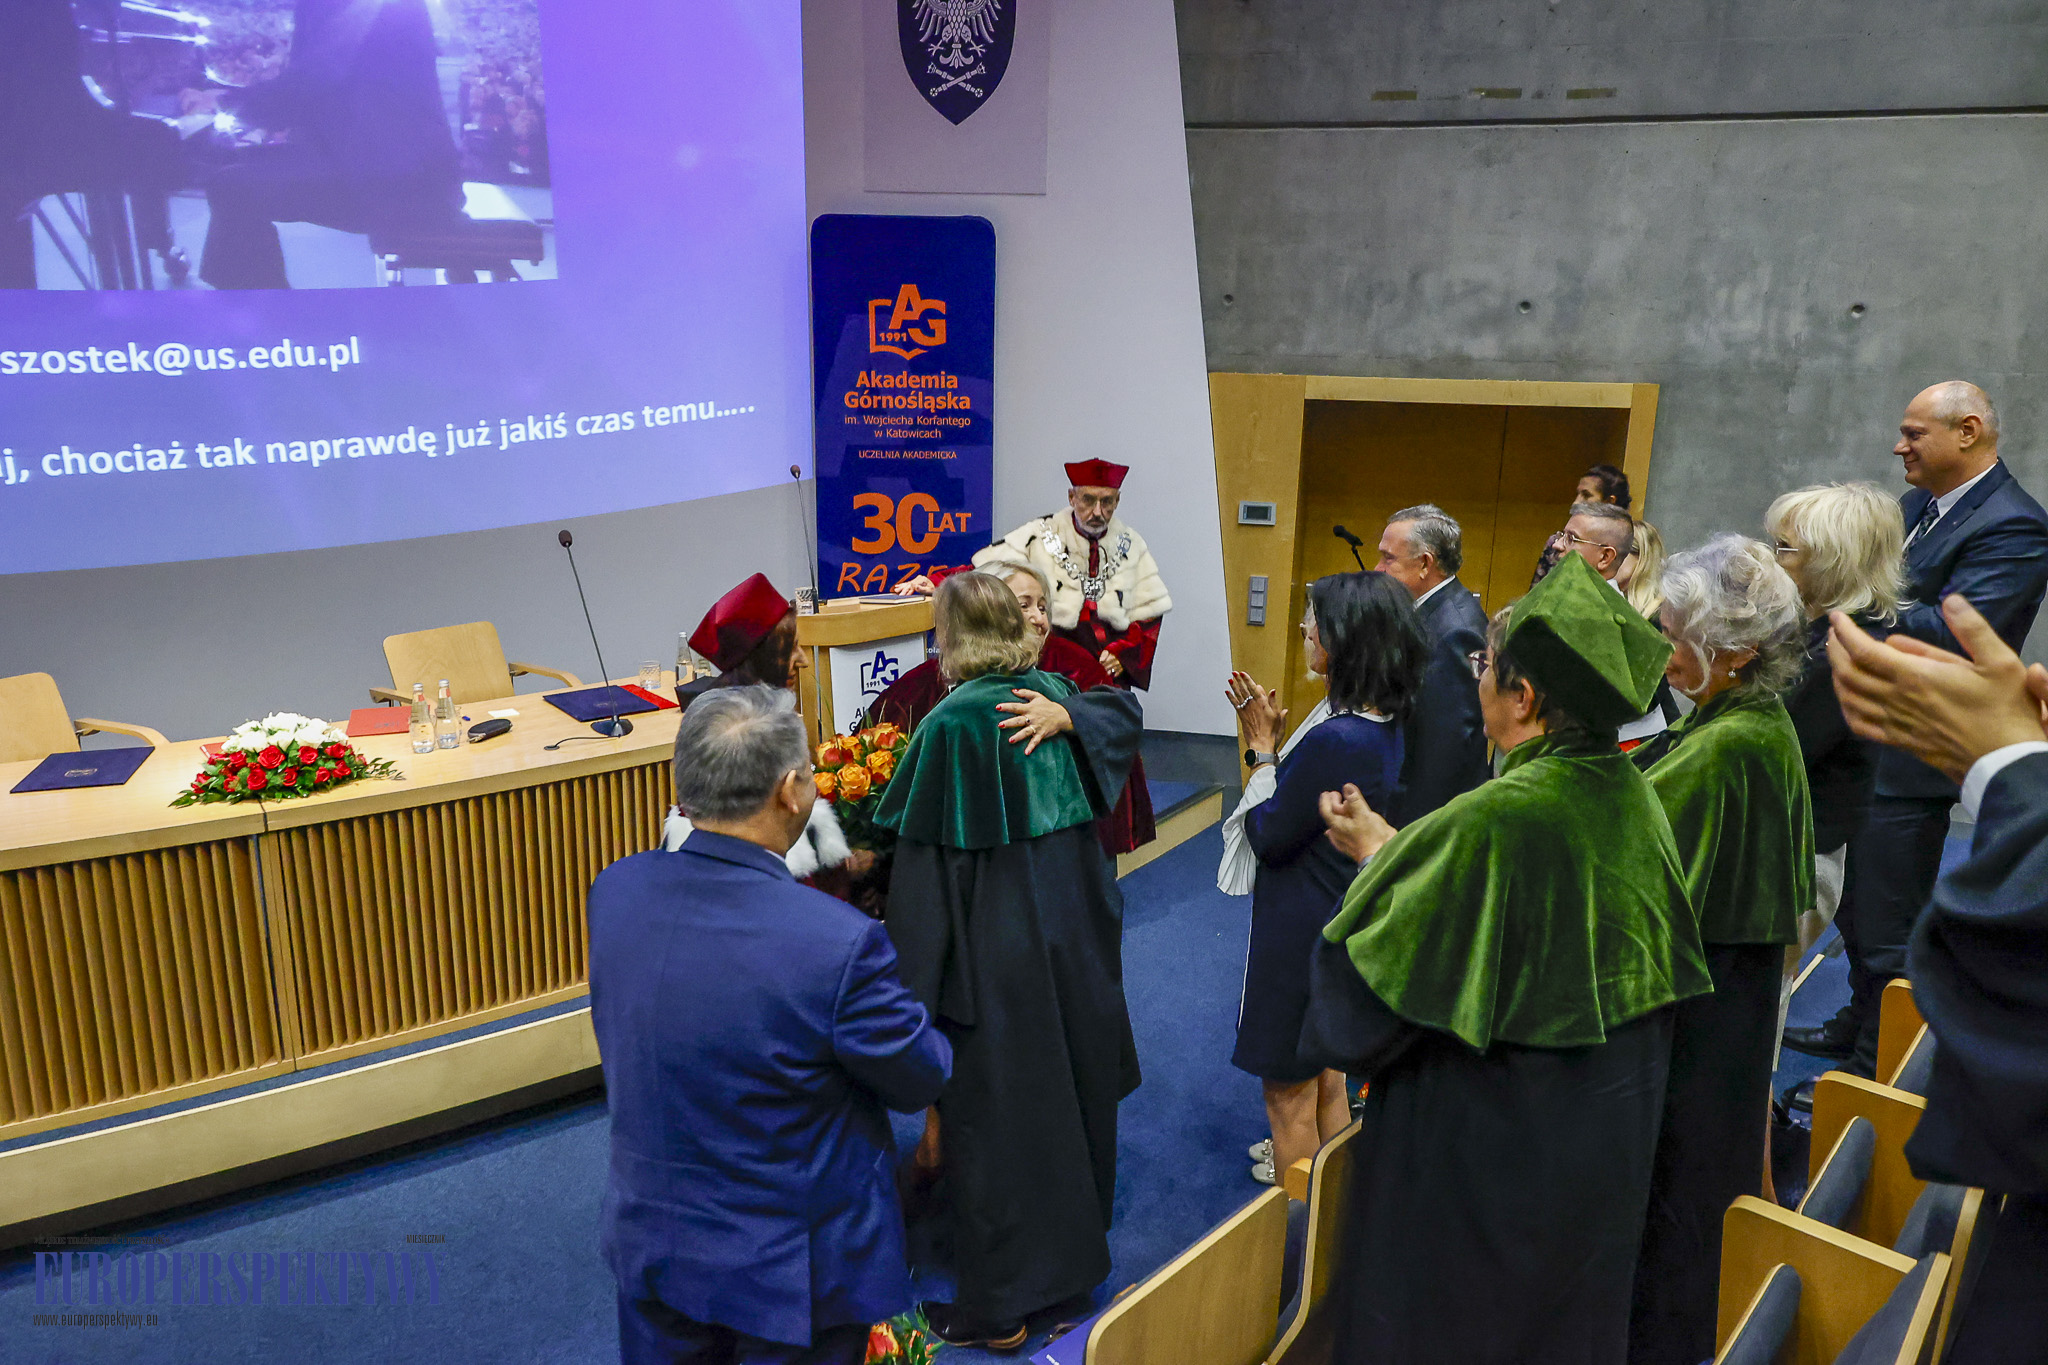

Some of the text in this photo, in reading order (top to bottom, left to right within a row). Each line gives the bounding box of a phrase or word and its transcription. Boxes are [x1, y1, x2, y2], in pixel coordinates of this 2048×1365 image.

[889, 284, 947, 346] AG
[879, 332, 907, 342] 1991
[0, 336, 361, 376] szostek@us.edu.pl
[856, 371, 958, 389] Akademia
[844, 391, 971, 413] Górnośląska
[844, 415, 971, 428] im. Wojciecha Korfantego
[874, 428, 942, 439] w Katowicach
[0, 448, 30, 485] j,
[42, 441, 188, 476] chociaż
[196, 438, 256, 469] tak
[266, 426, 437, 467] naprawdę
[446, 419, 492, 456] już
[500, 412, 568, 450] jakiś
[576, 411, 635, 436] czas
[858, 450, 957, 459] UCZELNIA AKADEMICKA
[927, 512, 972, 533] LAT
[866, 680, 880, 688] 1991
